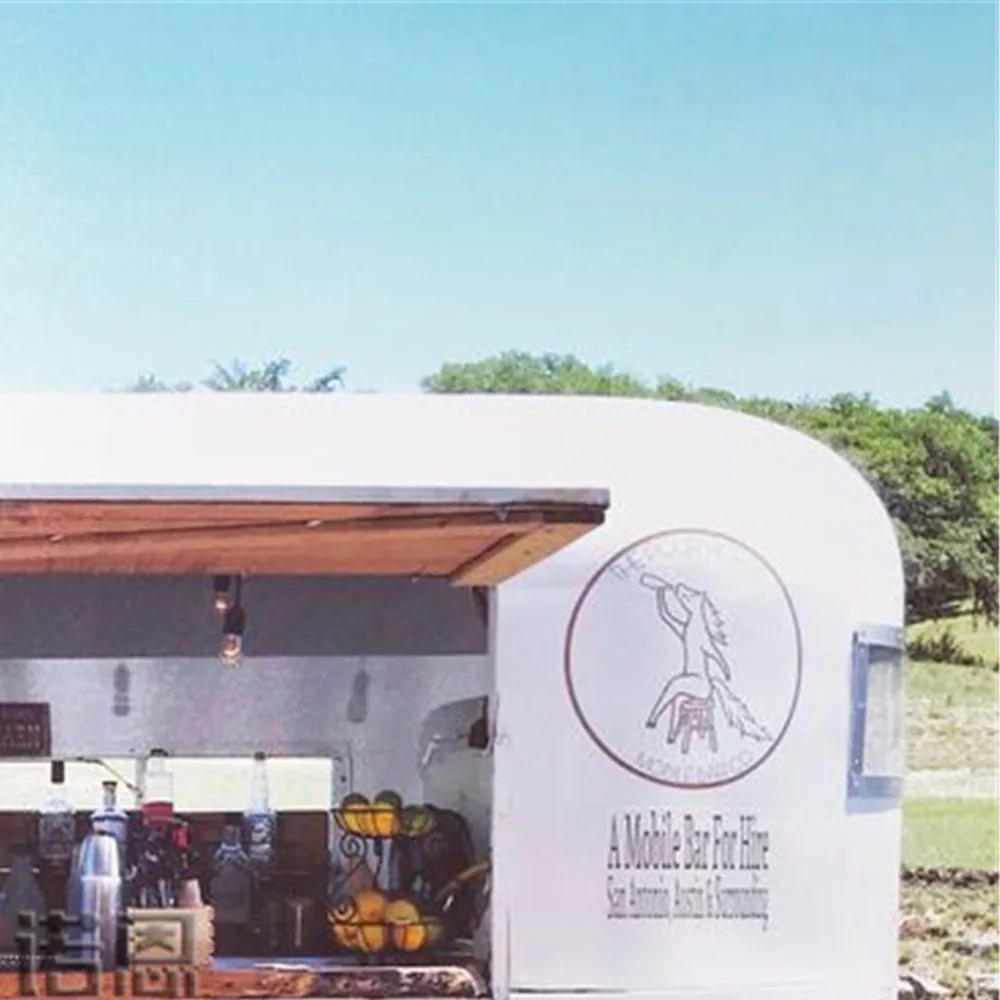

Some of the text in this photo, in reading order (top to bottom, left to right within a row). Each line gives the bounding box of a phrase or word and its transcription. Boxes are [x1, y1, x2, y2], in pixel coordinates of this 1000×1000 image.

[607, 810, 769, 870] A Mobile Bar For Hire
